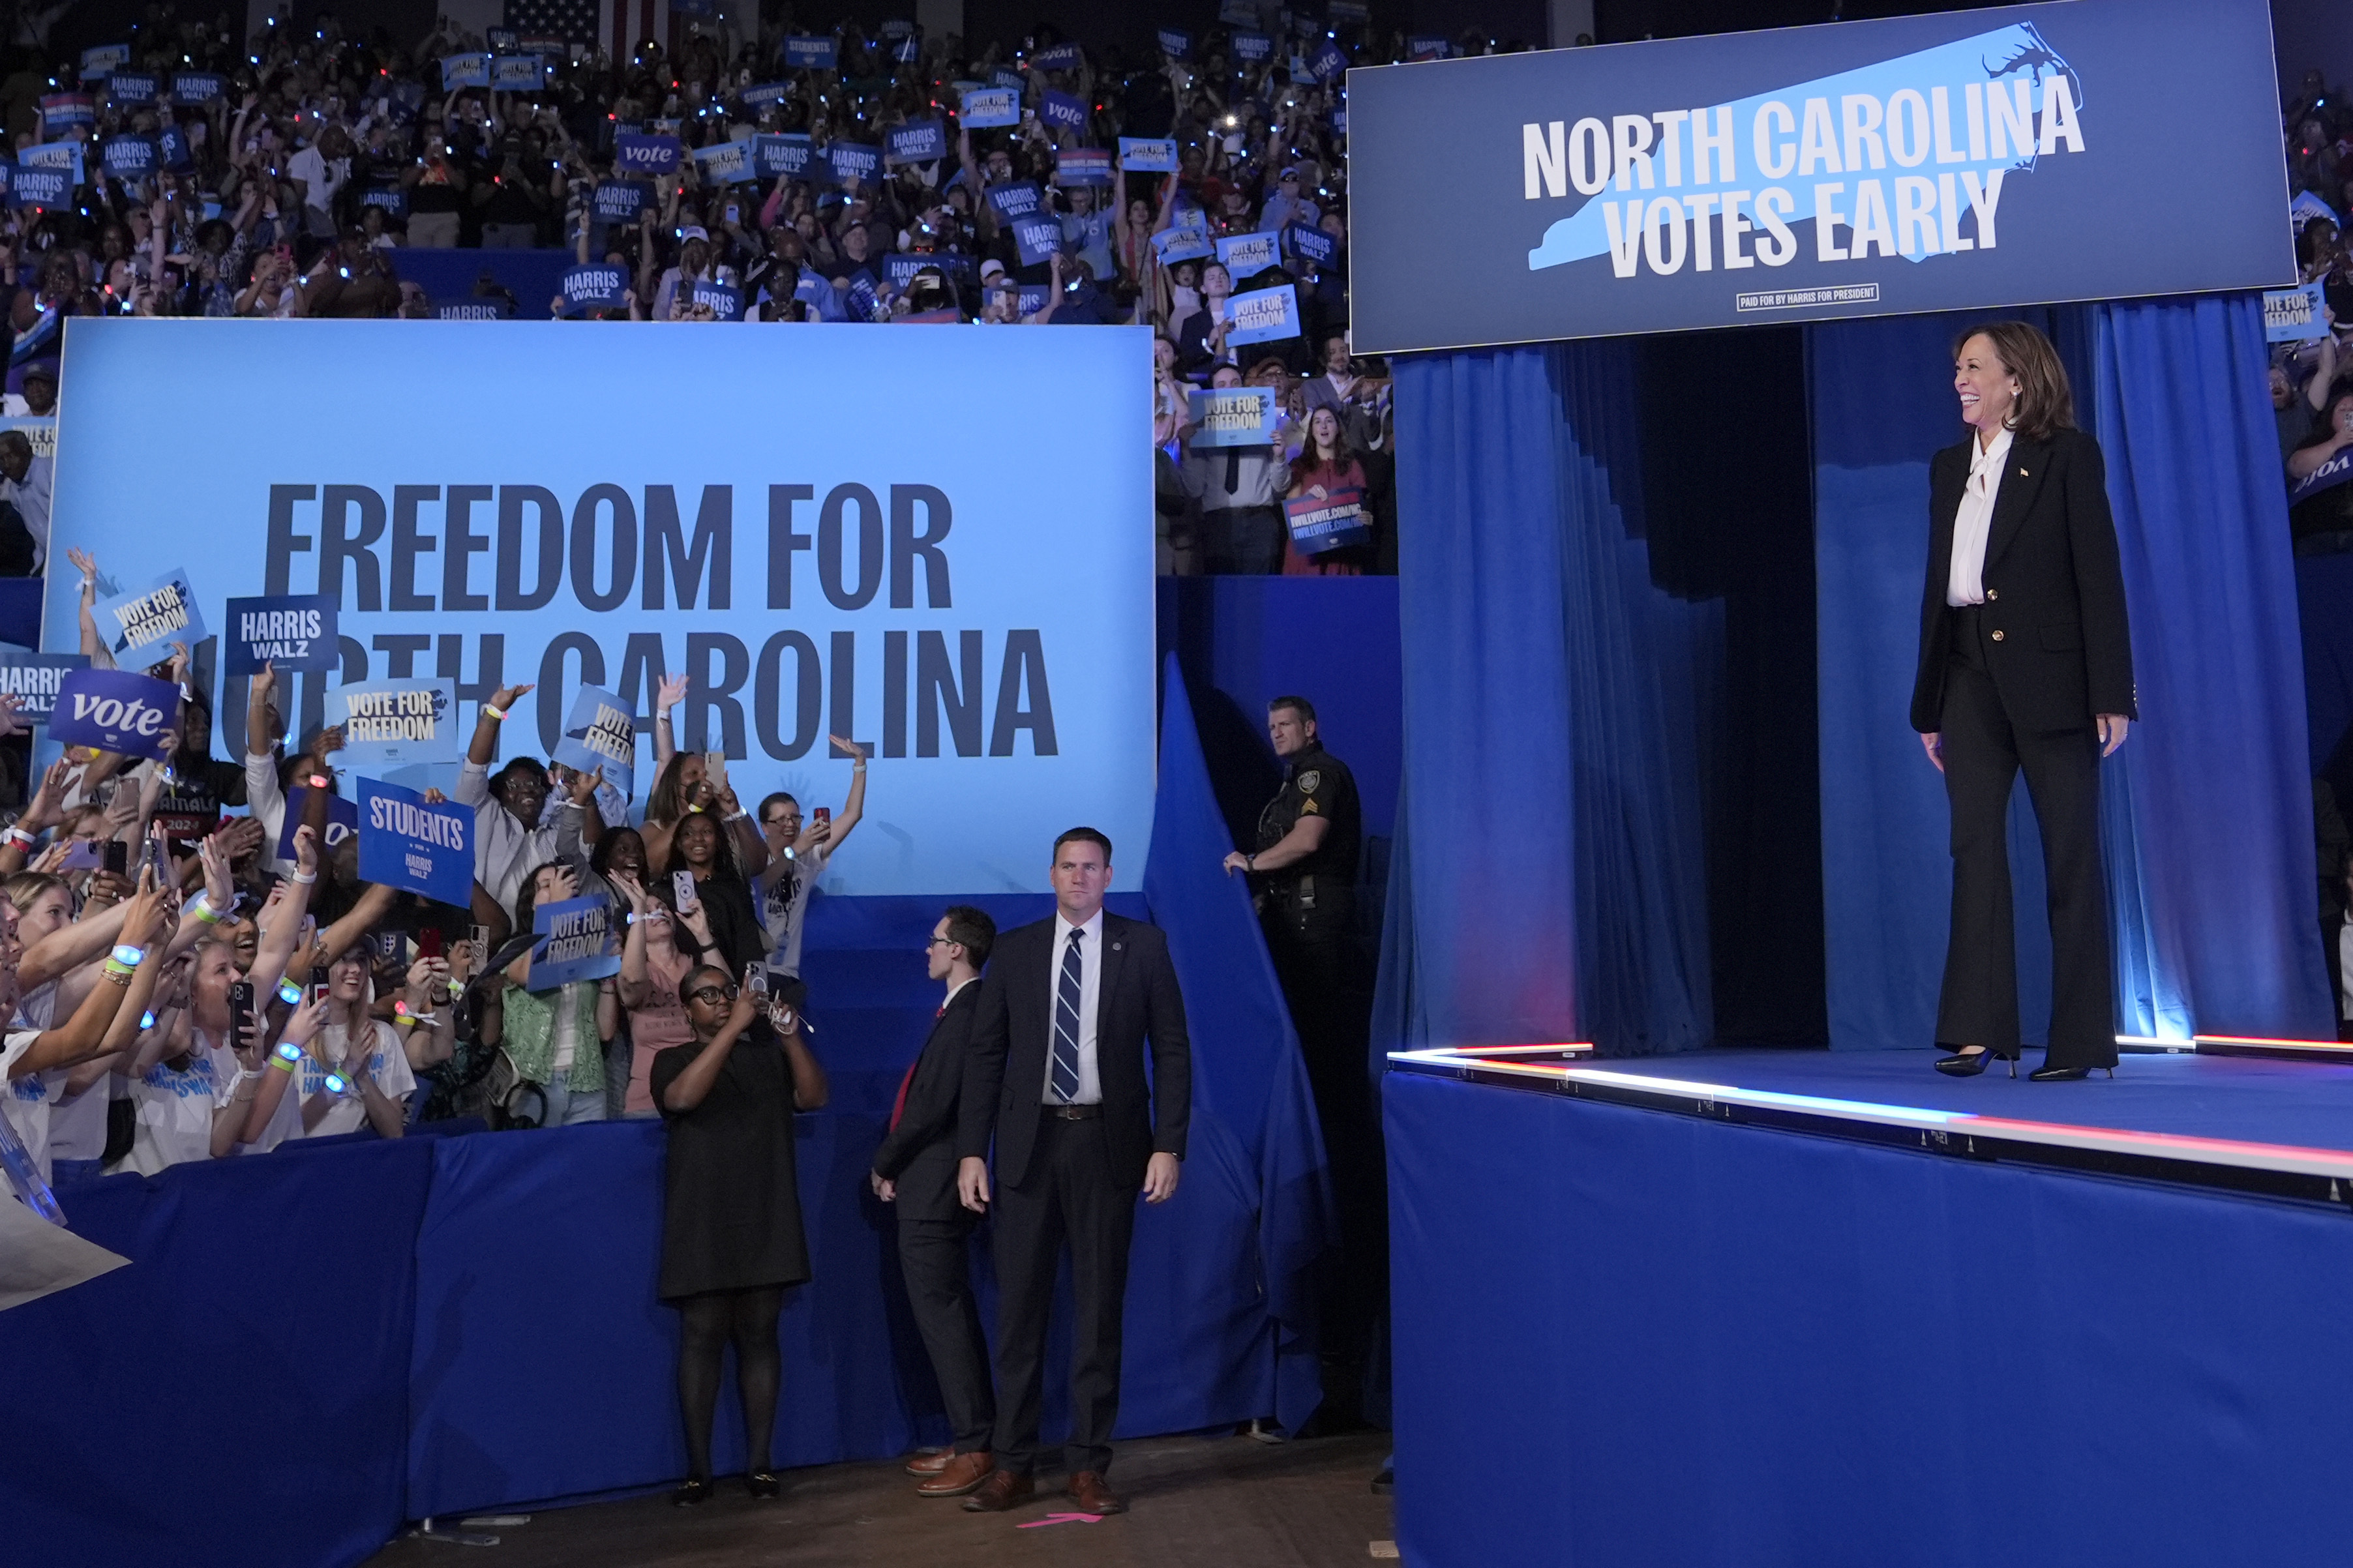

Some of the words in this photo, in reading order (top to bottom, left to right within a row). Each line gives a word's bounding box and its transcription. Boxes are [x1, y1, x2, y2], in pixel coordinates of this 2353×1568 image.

[789, 39, 830, 53] STUDENTS
[112, 76, 154, 93] HARRIS
[176, 78, 218, 94] HARRIS
[1048, 102, 1083, 125] vote
[892, 128, 937, 149] HARRIS
[1523, 105, 1736, 200] NORTH
[1752, 75, 2085, 179] CAROLINA
[104, 141, 152, 161] HARRIS
[625, 145, 673, 162] vote
[764, 145, 809, 164] HARRIS
[832, 149, 877, 170] HARRIS
[900, 143, 931, 156] WALZ
[112, 158, 147, 170] WALZ
[770, 162, 801, 173] WALZ
[837, 166, 868, 179] WALZ
[13, 173, 63, 192] HARRIS
[20, 190, 55, 202] WALZ
[595, 186, 641, 207] HARRIS
[995, 187, 1038, 209] HARRIS
[599, 203, 633, 216] WALZ
[1006, 201, 1037, 216] WALZ
[1602, 186, 1797, 278] VOTES
[1816, 168, 2005, 263] EARLY
[1255, 238, 1268, 253] FOR
[1294, 227, 1330, 254] HARRIS
[1228, 251, 1271, 267] FREEDOM
[1299, 244, 1326, 261] WALZ
[564, 271, 619, 295] HARRIS
[571, 288, 611, 302] WALZ
[693, 289, 735, 314] ARRIS
[1741, 297, 1758, 308] PAID
[1760, 295, 1774, 306] FOR
[1775, 294, 1787, 305] BY
[1788, 292, 1816, 304] HARRIS
[1818, 291, 1833, 302] FOR
[1834, 287, 1875, 300] PRESIDENT
[2285, 293, 2309, 310] FOR
[440, 304, 497, 320] HARRIS
[1234, 297, 1261, 317] VOTE
[1261, 294, 1283, 313] FOR
[1234, 310, 1285, 331] FREEDOM
[1205, 397, 1235, 415] VOTE
[1236, 395, 1260, 412] FOR
[1205, 412, 1261, 431] FREEDOM
[263, 482, 734, 612] FREEDOM
[766, 482, 953, 611] FOR
[112, 596, 155, 629] VOTE
[149, 585, 181, 613] FOR
[123, 604, 189, 651] FREEDOM
[241, 609, 322, 642] HARRIS
[252, 640, 309, 660] WALZ
[346, 691, 393, 717] VOTE
[397, 690, 433, 716] FOR
[73, 693, 163, 736] vote
[595, 703, 632, 740] VOTE
[348, 715, 435, 743] FREEDOM
[369, 795, 464, 851] STUDENTS
[405, 853, 432, 872] HARRIS
[409, 868, 428, 880] WALZ
[550, 911, 582, 939] VOTE
[582, 906, 606, 934] FOR
[547, 931, 605, 966] FREEDOM
